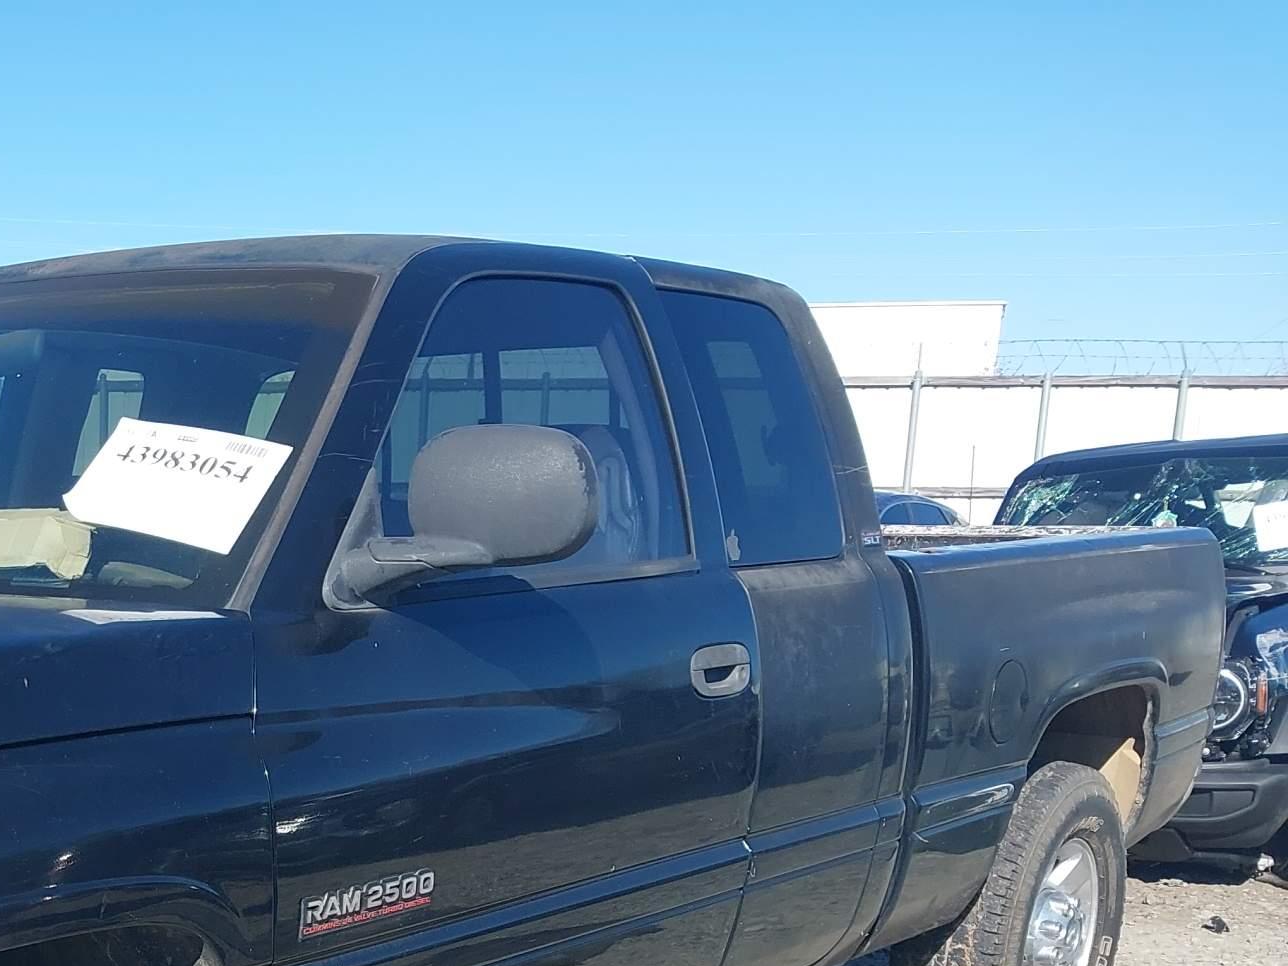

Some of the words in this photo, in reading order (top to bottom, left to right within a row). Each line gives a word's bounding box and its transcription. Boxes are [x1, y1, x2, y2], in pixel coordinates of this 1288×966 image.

[117, 445, 254, 483] 43983054
[864, 535, 880, 545] SLT
[305, 889, 362, 924] RAM
[367, 871, 435, 909] 2500
